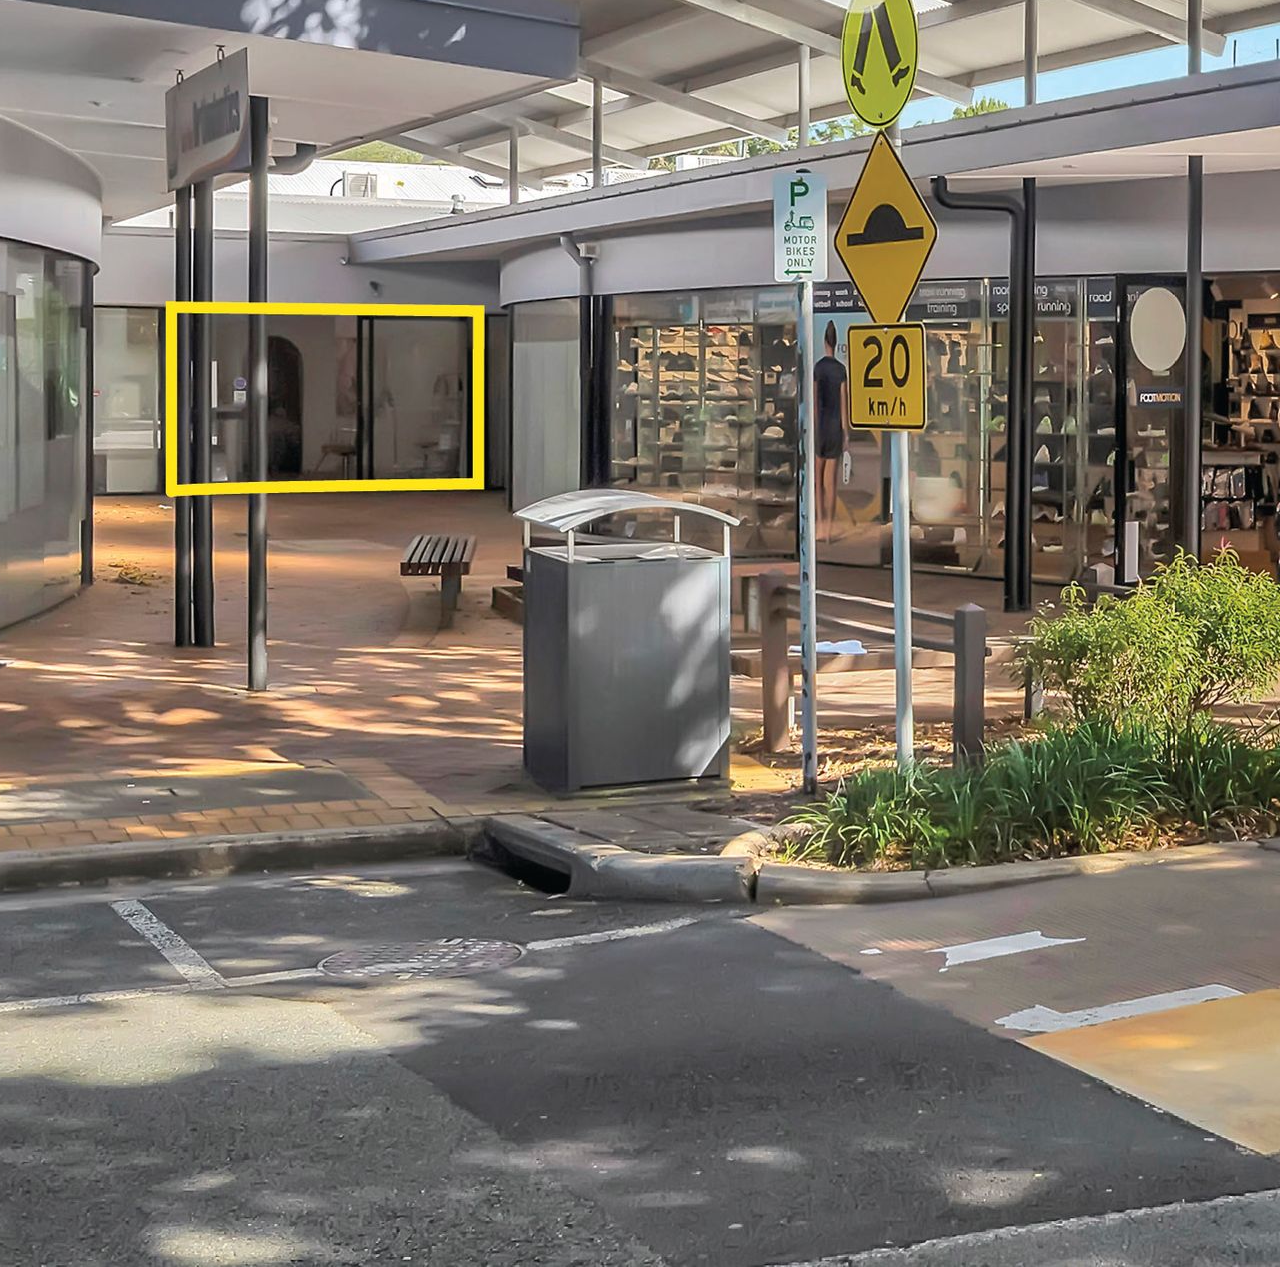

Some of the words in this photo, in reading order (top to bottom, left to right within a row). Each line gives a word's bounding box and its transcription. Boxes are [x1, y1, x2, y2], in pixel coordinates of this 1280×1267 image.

[790, 181, 810, 207] P
[783, 235, 817, 245] MOTOR
[785, 246, 816, 256] BIKES
[786, 258, 814, 267] ONLY
[1089, 291, 1112, 303] road
[927, 302, 958, 316] training
[1037, 300, 1071, 316] running
[862, 334, 911, 389] 20
[868, 396, 907, 417] km/h
